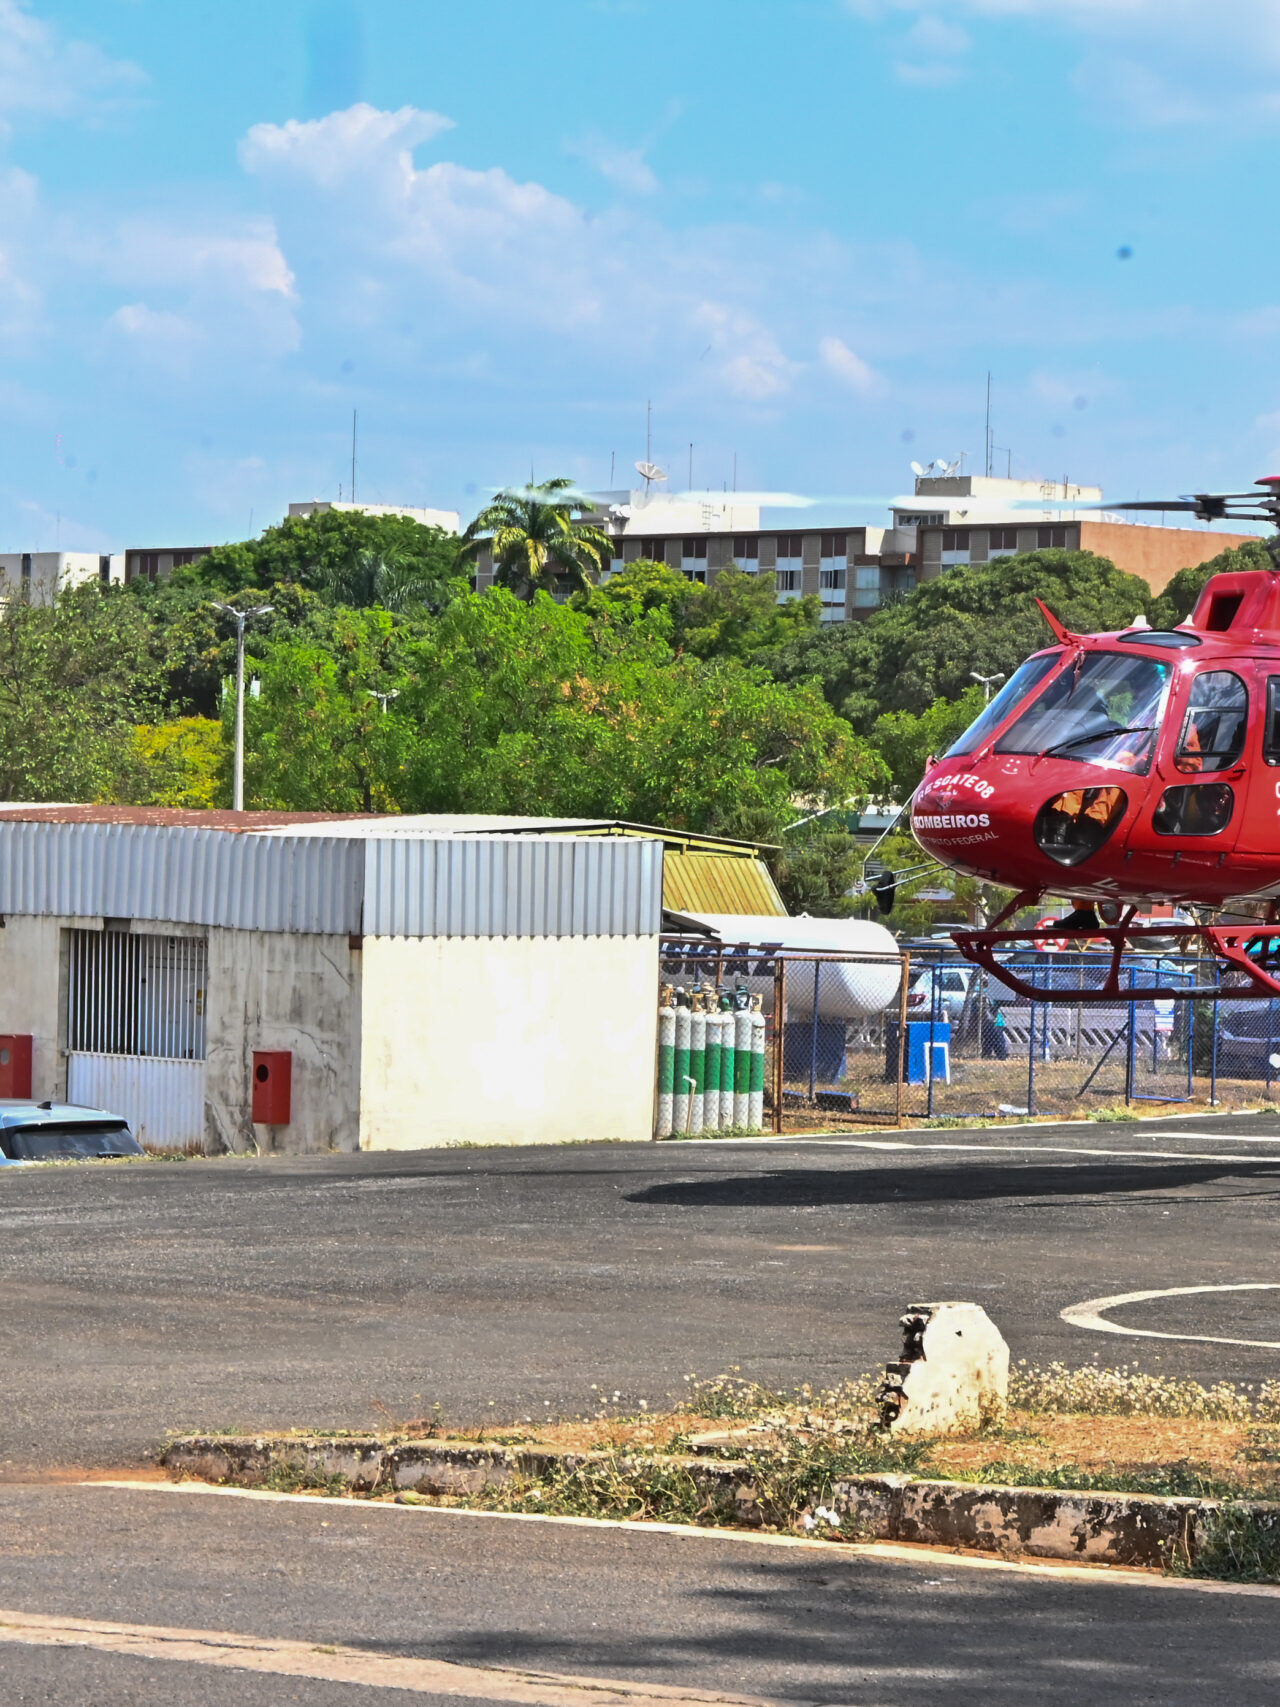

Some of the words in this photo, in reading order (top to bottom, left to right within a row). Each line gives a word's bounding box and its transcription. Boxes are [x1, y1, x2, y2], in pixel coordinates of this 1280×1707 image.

[917, 774, 979, 802] RESGATE
[974, 780, 995, 799] 08
[913, 813, 990, 829] BOMBEIROS
[952, 831, 999, 846] FEDERAL
